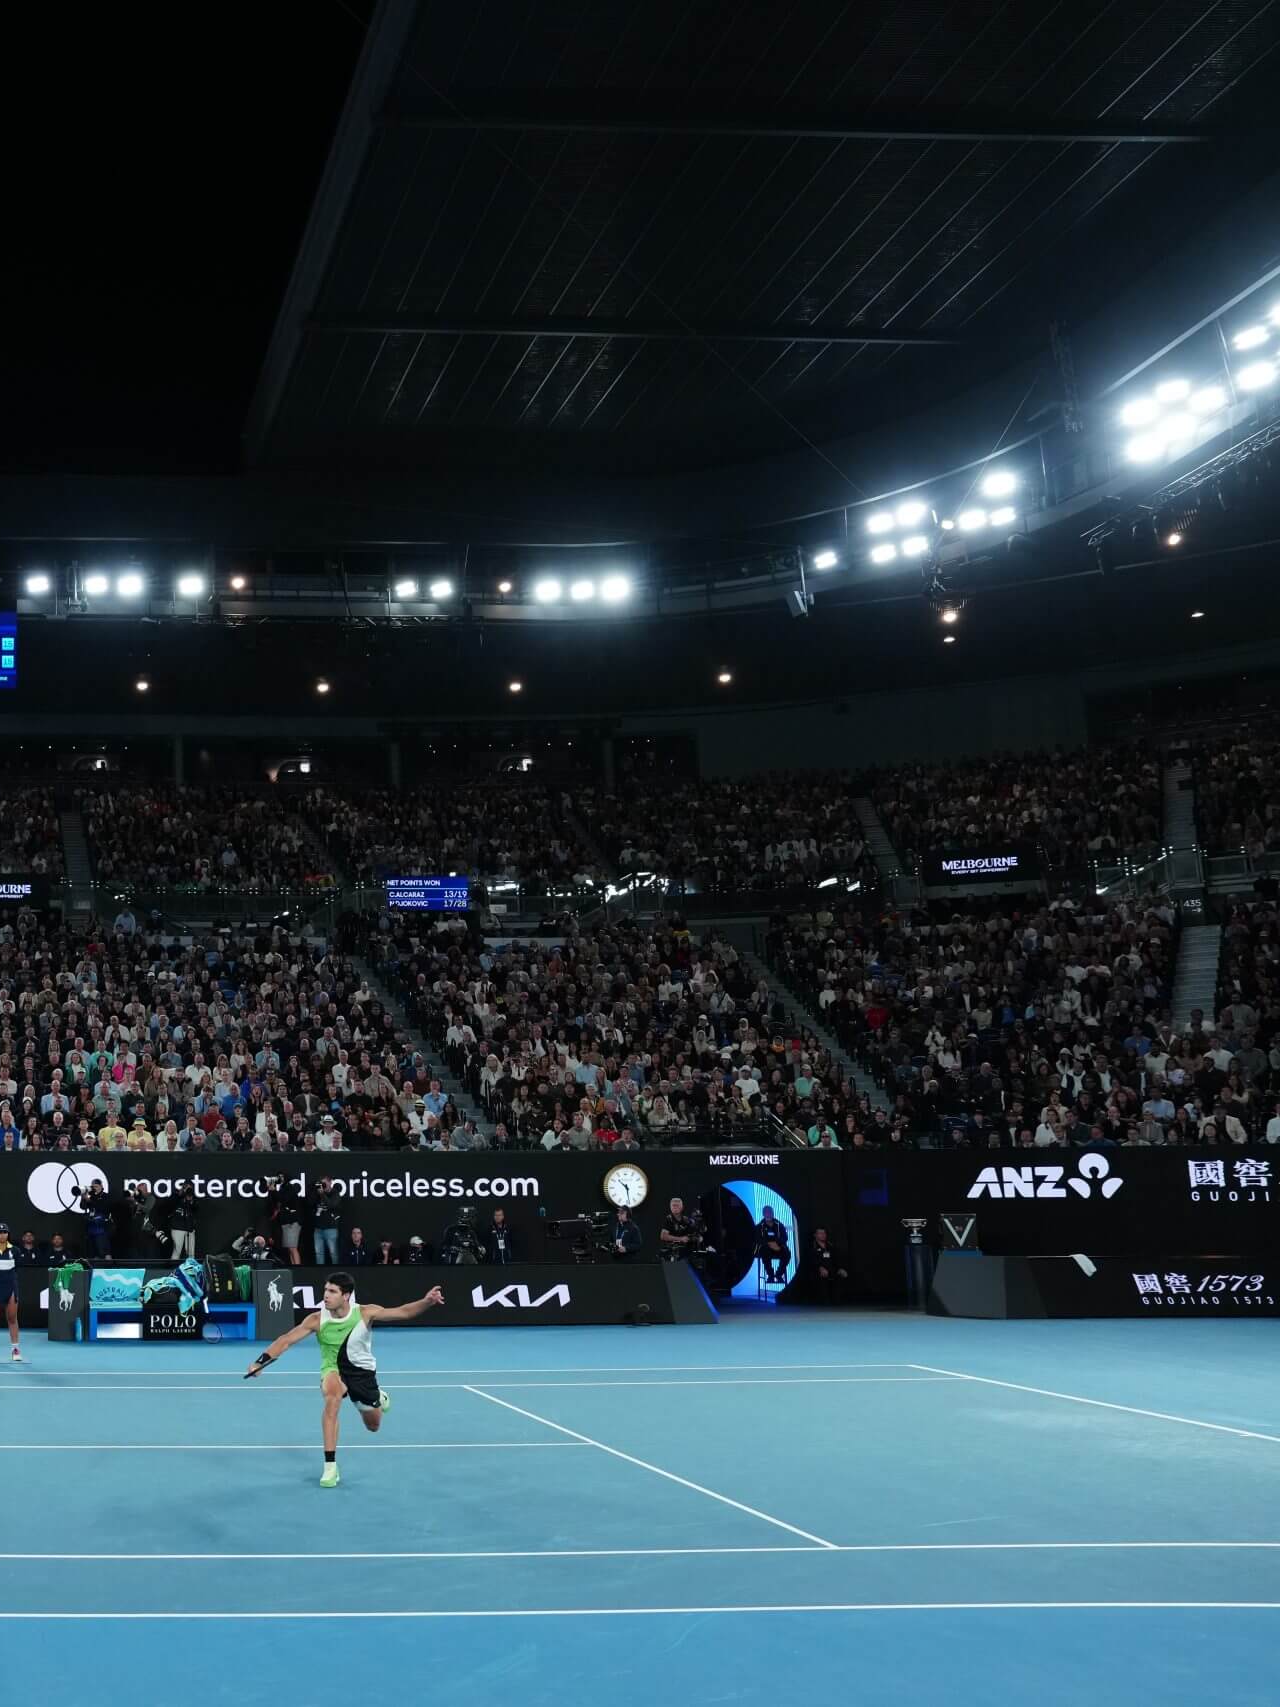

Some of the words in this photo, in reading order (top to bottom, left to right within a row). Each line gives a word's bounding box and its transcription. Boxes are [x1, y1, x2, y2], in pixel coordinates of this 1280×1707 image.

[942, 856, 1019, 871] MELBOURNE
[444, 890, 468, 898] 13/19
[709, 1154, 780, 1165] MELBOURNE
[1187, 1158, 1273, 1188] 國窖
[966, 1166, 1067, 1199] ANZ
[471, 1284, 571, 1307] KIA
[1142, 1297, 1220, 1305] GUOJIAO
[1233, 1297, 1274, 1305] 1573
[150, 1314, 197, 1328] POLO
